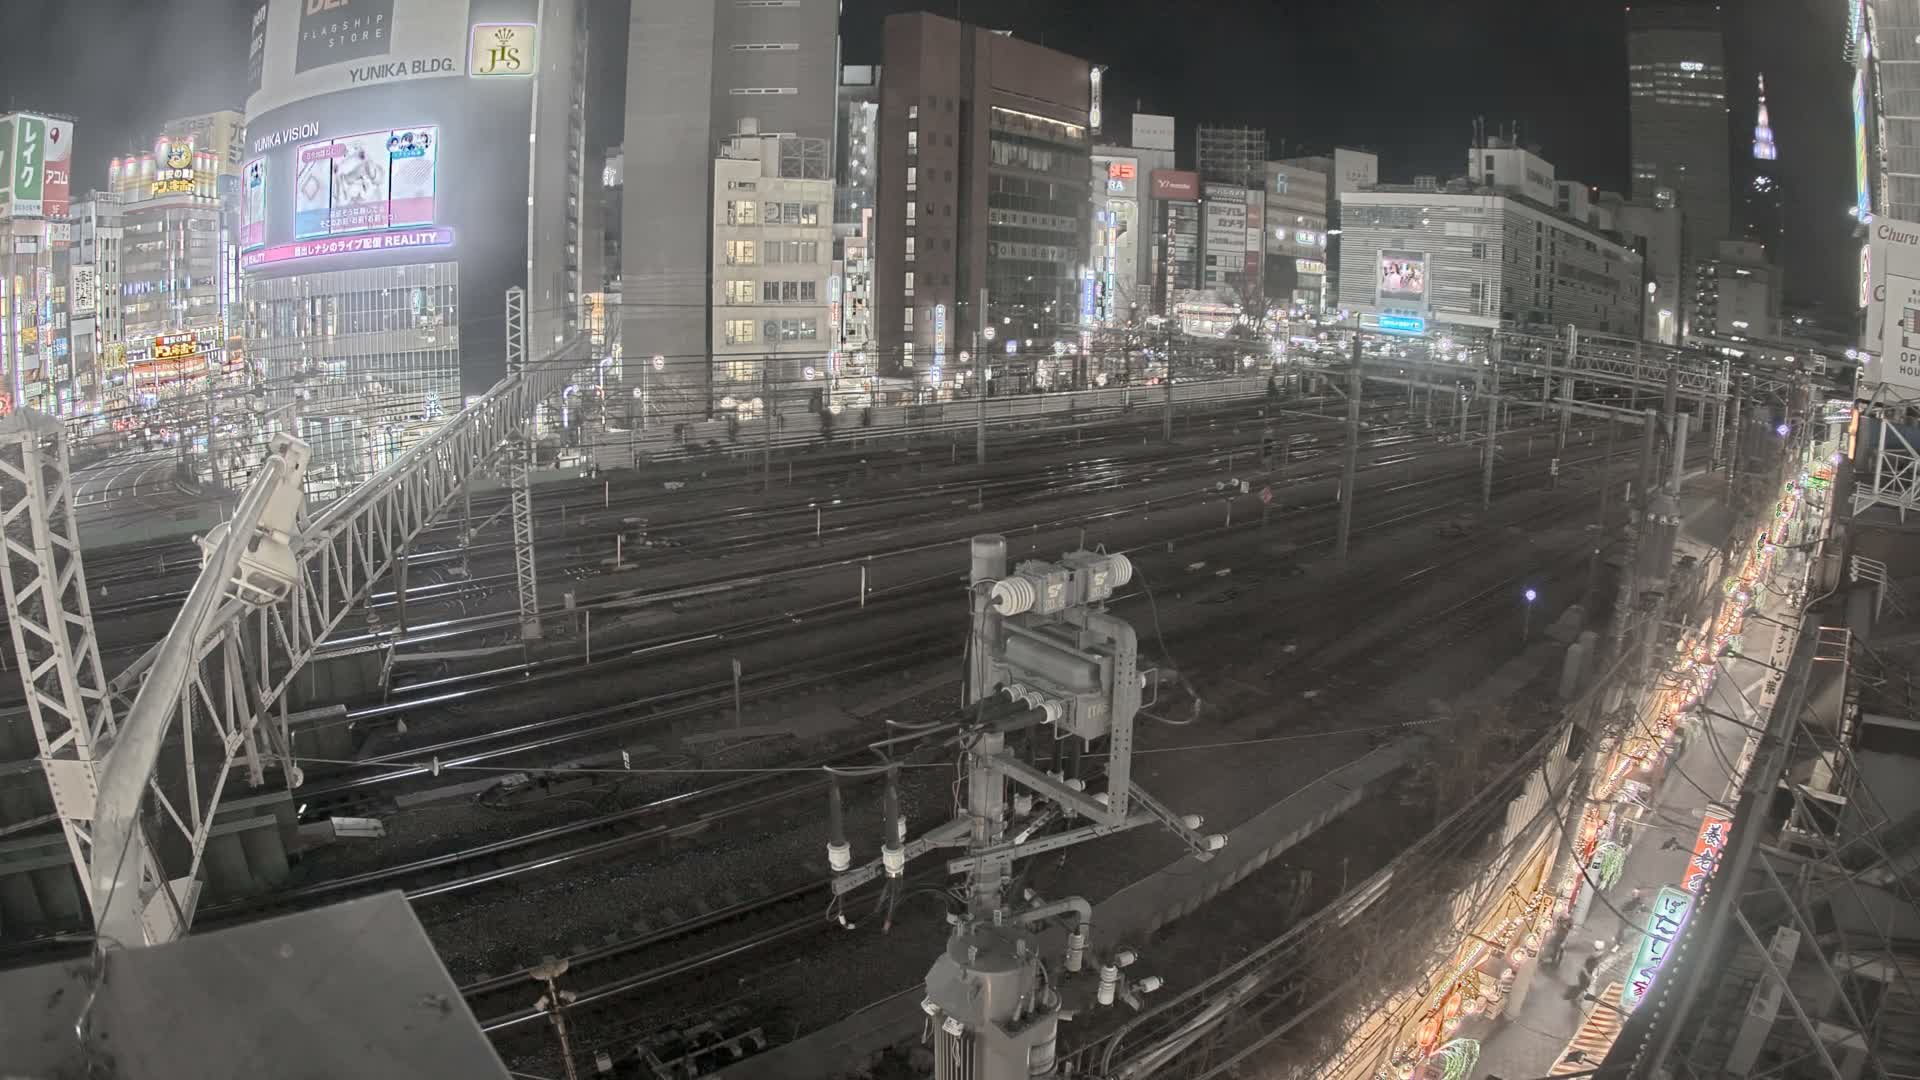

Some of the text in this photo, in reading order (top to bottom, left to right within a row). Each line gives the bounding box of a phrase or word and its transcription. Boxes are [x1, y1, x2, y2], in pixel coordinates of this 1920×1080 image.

[303, 14, 383, 41] FLAGSHIP
[328, 28, 382, 48] STORE
[350, 58, 456, 83] YUNIKA BLDG.
[254, 132, 281, 153] YUNIKA
[282, 121, 320, 145] VISION
[21, 121, 37, 188] レイク
[45, 169, 69, 185] アコム
[384, 232, 437, 246] REALITY
